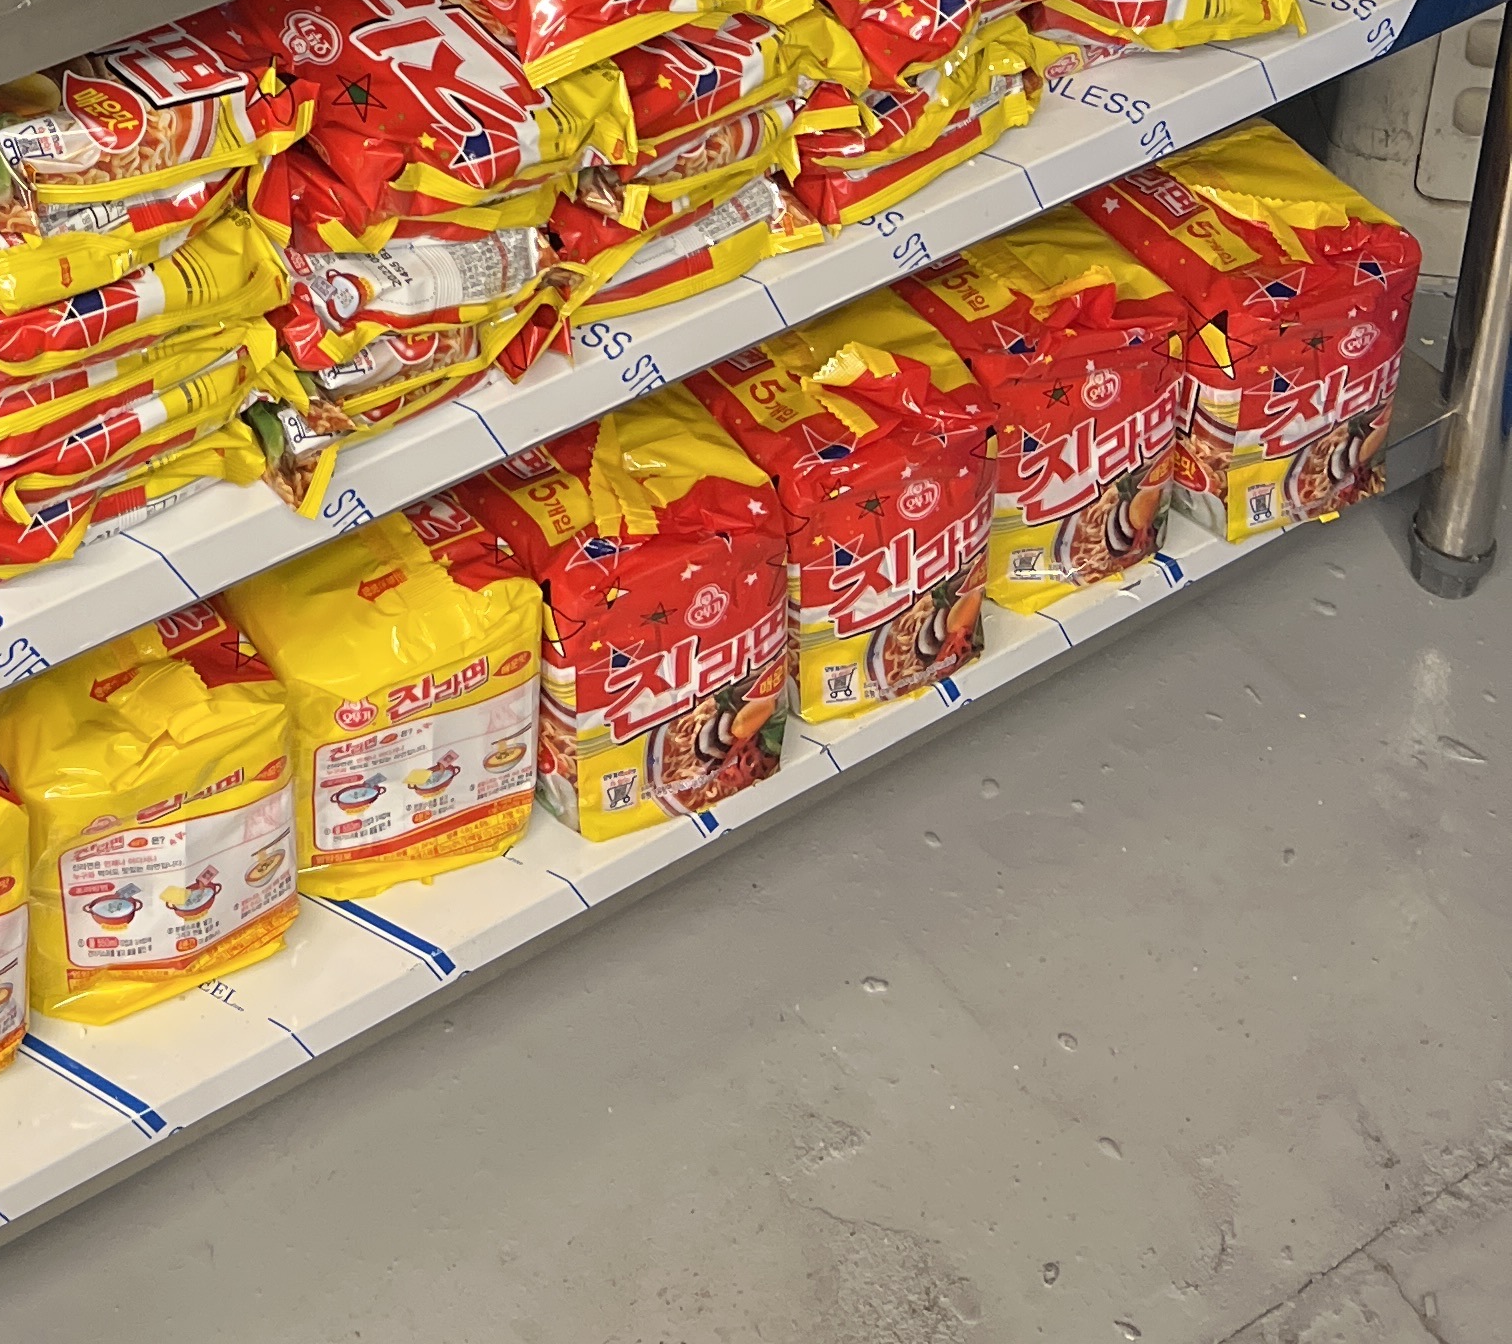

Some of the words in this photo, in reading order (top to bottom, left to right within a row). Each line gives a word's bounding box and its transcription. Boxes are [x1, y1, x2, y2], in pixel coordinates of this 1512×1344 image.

[71, 85, 140, 132] 매운맛
[1017, 379, 1178, 527] 진라면
[527, 478, 576, 536] 5개입
[387, 655, 489, 723] 진라면
